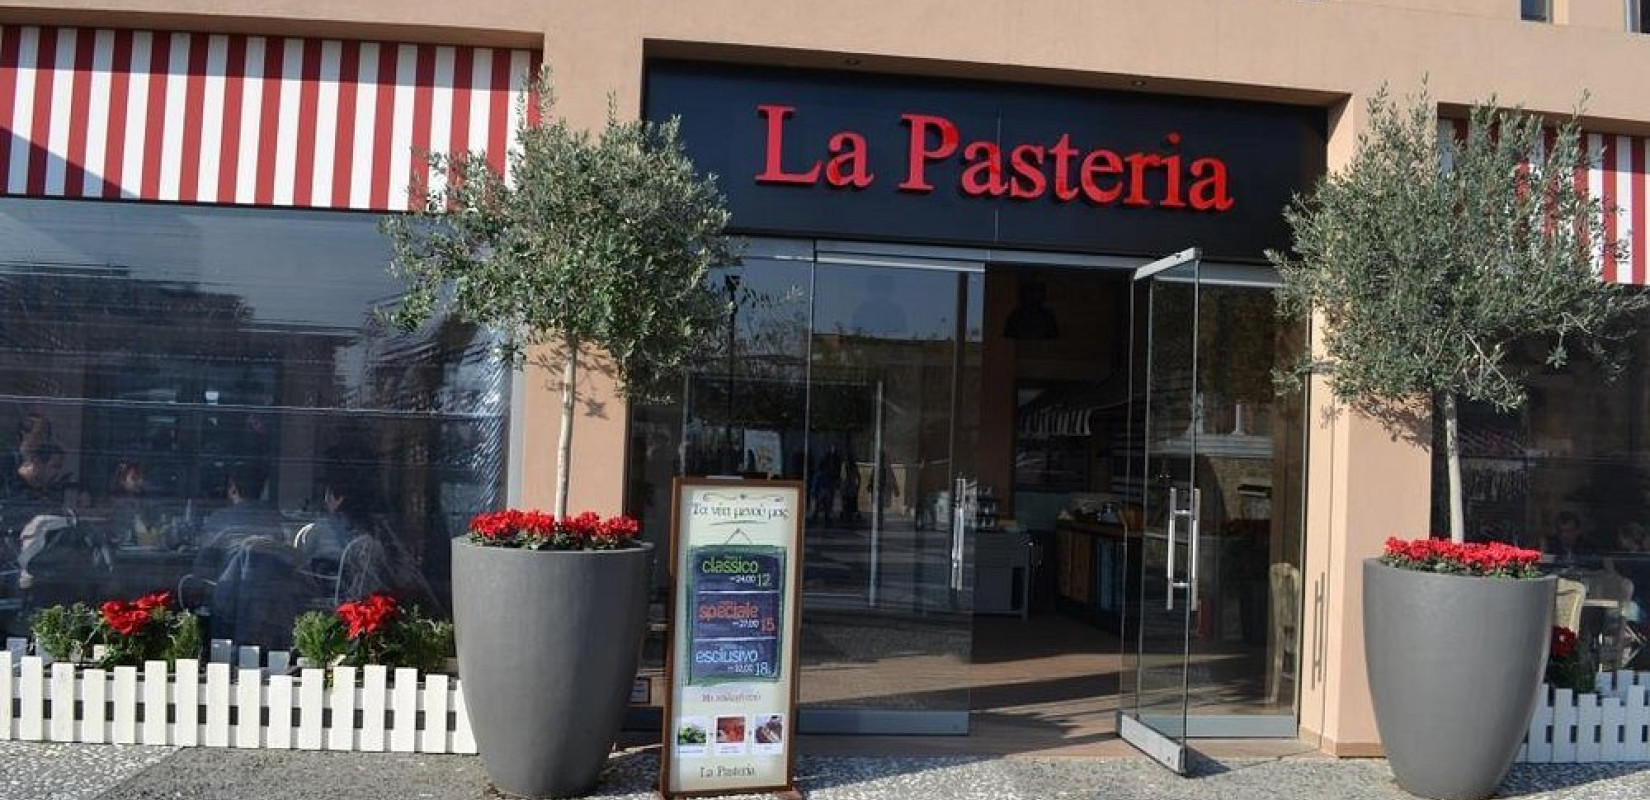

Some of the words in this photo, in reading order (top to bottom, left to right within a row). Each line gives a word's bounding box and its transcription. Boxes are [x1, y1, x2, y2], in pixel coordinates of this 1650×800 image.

[755, 105, 873, 188] La
[898, 113, 1234, 211] Pasteria
[702, 556, 758, 574] classico
[699, 602, 759, 621] speciale
[695, 646, 758, 663] esclusivo
[700, 766, 714, 778] La
